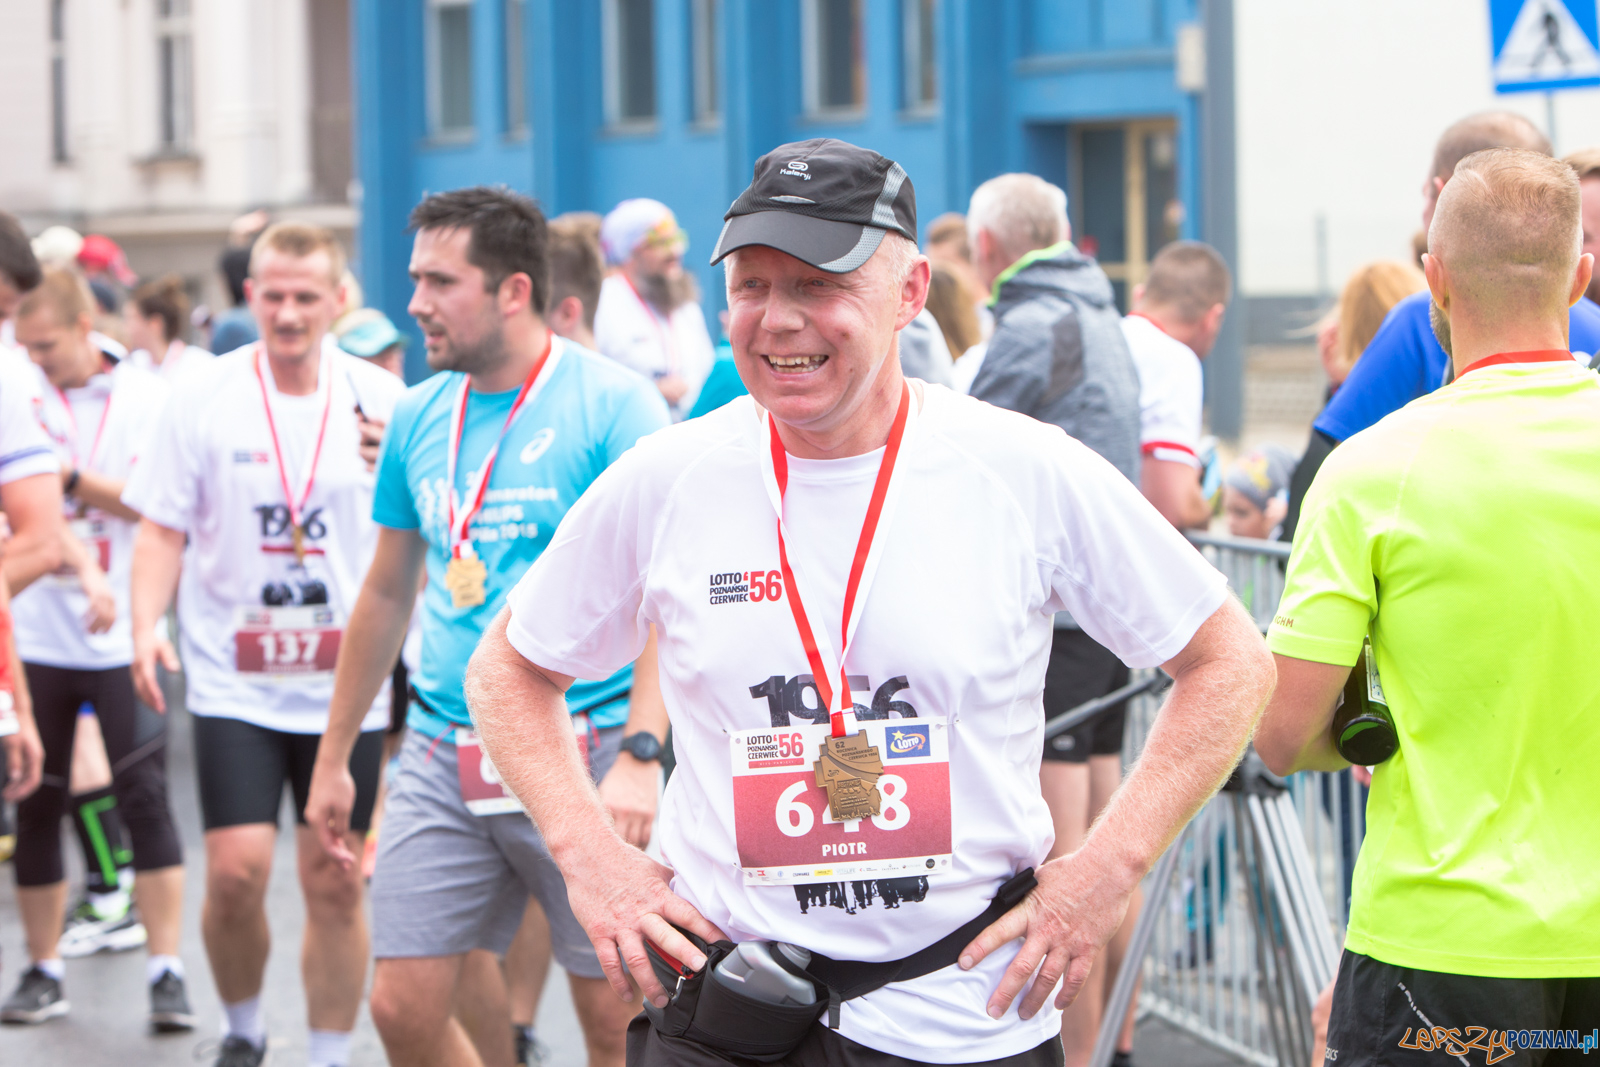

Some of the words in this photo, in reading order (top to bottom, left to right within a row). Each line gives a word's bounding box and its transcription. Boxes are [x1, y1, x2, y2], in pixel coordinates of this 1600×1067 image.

[780, 168, 812, 181] Kalenji
[253, 504, 328, 540] 196
[709, 572, 742, 586] LOTTO
[743, 570, 783, 603] '56
[709, 583, 748, 596] POZNAŃSKI
[709, 593, 748, 605] CZERWIEC
[257, 633, 322, 663] 137
[746, 734, 772, 746] LOTTO
[773, 732, 804, 758] '56
[747, 743, 778, 752] POZNAŃSKI
[835, 741, 845, 749] 62
[897, 736, 919, 750] LOTTO
[747, 751, 779, 760] CZERWIEC
[822, 842, 867, 857] PIOTR
